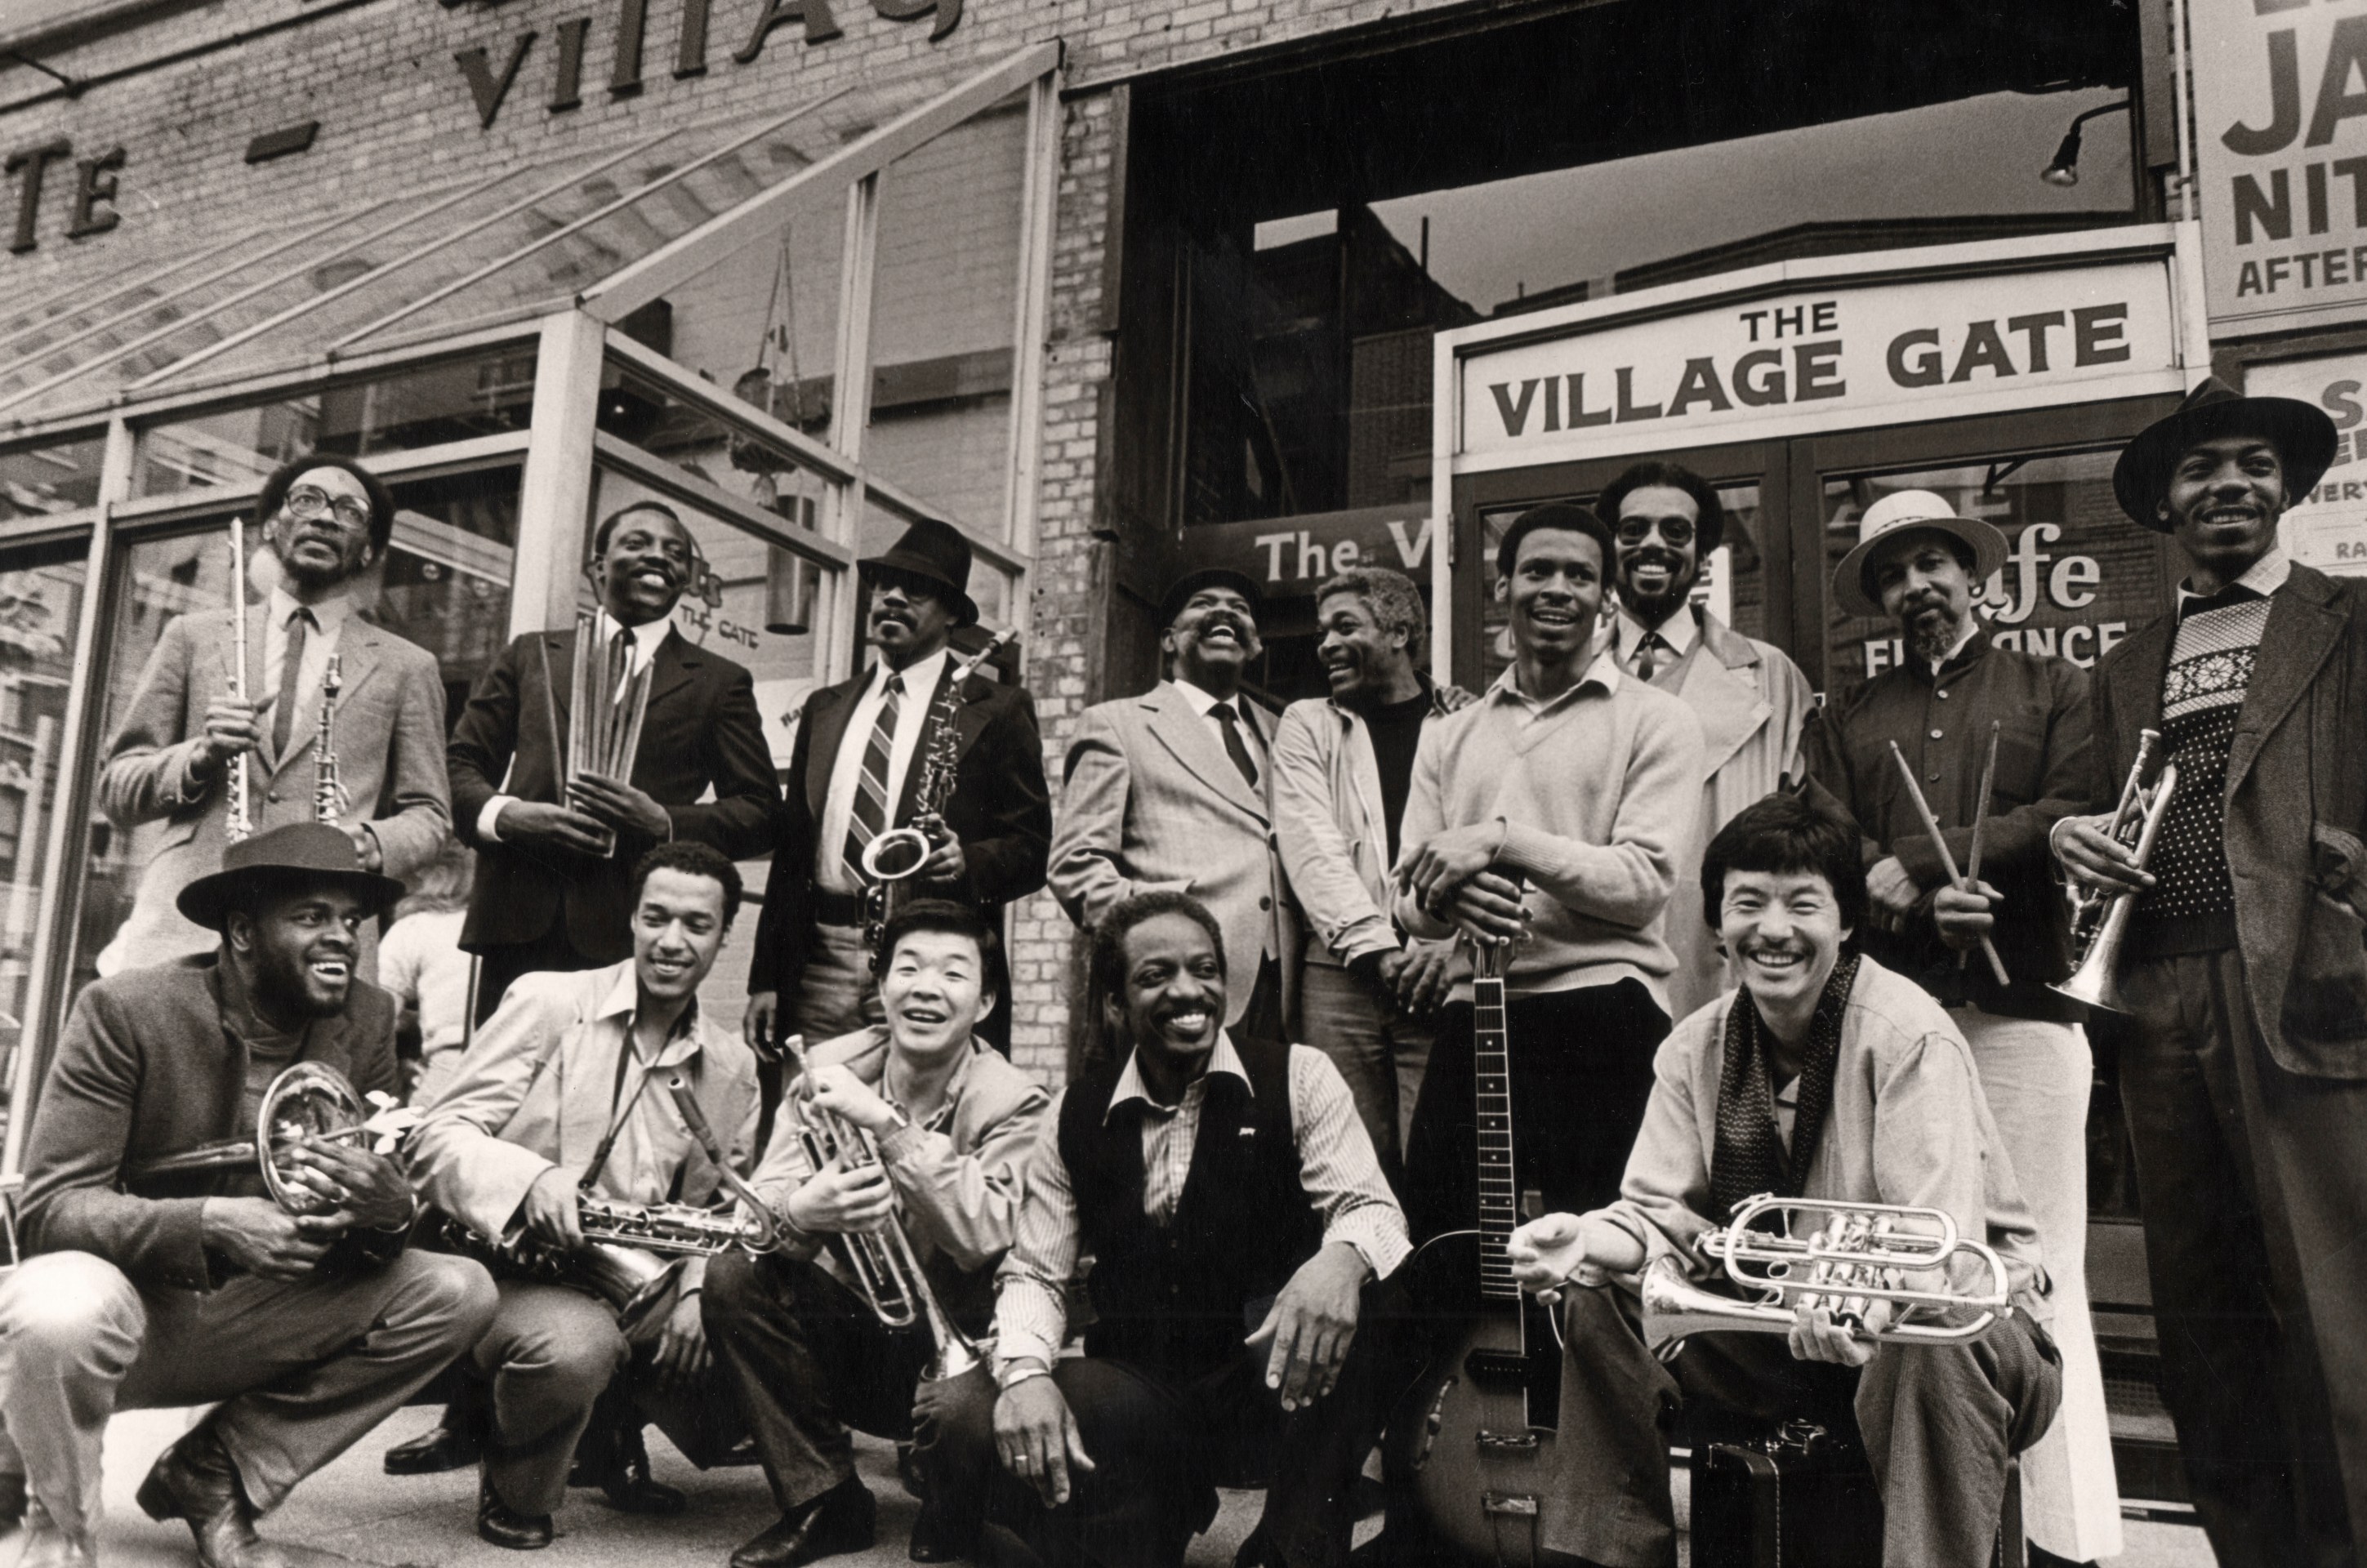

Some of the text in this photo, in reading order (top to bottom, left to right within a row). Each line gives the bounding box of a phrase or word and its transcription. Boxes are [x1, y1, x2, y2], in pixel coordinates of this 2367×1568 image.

[1740, 301, 1839, 342] THE
[1489, 302, 2131, 437] VILLAGE GATE
[1255, 532, 1359, 581] The
